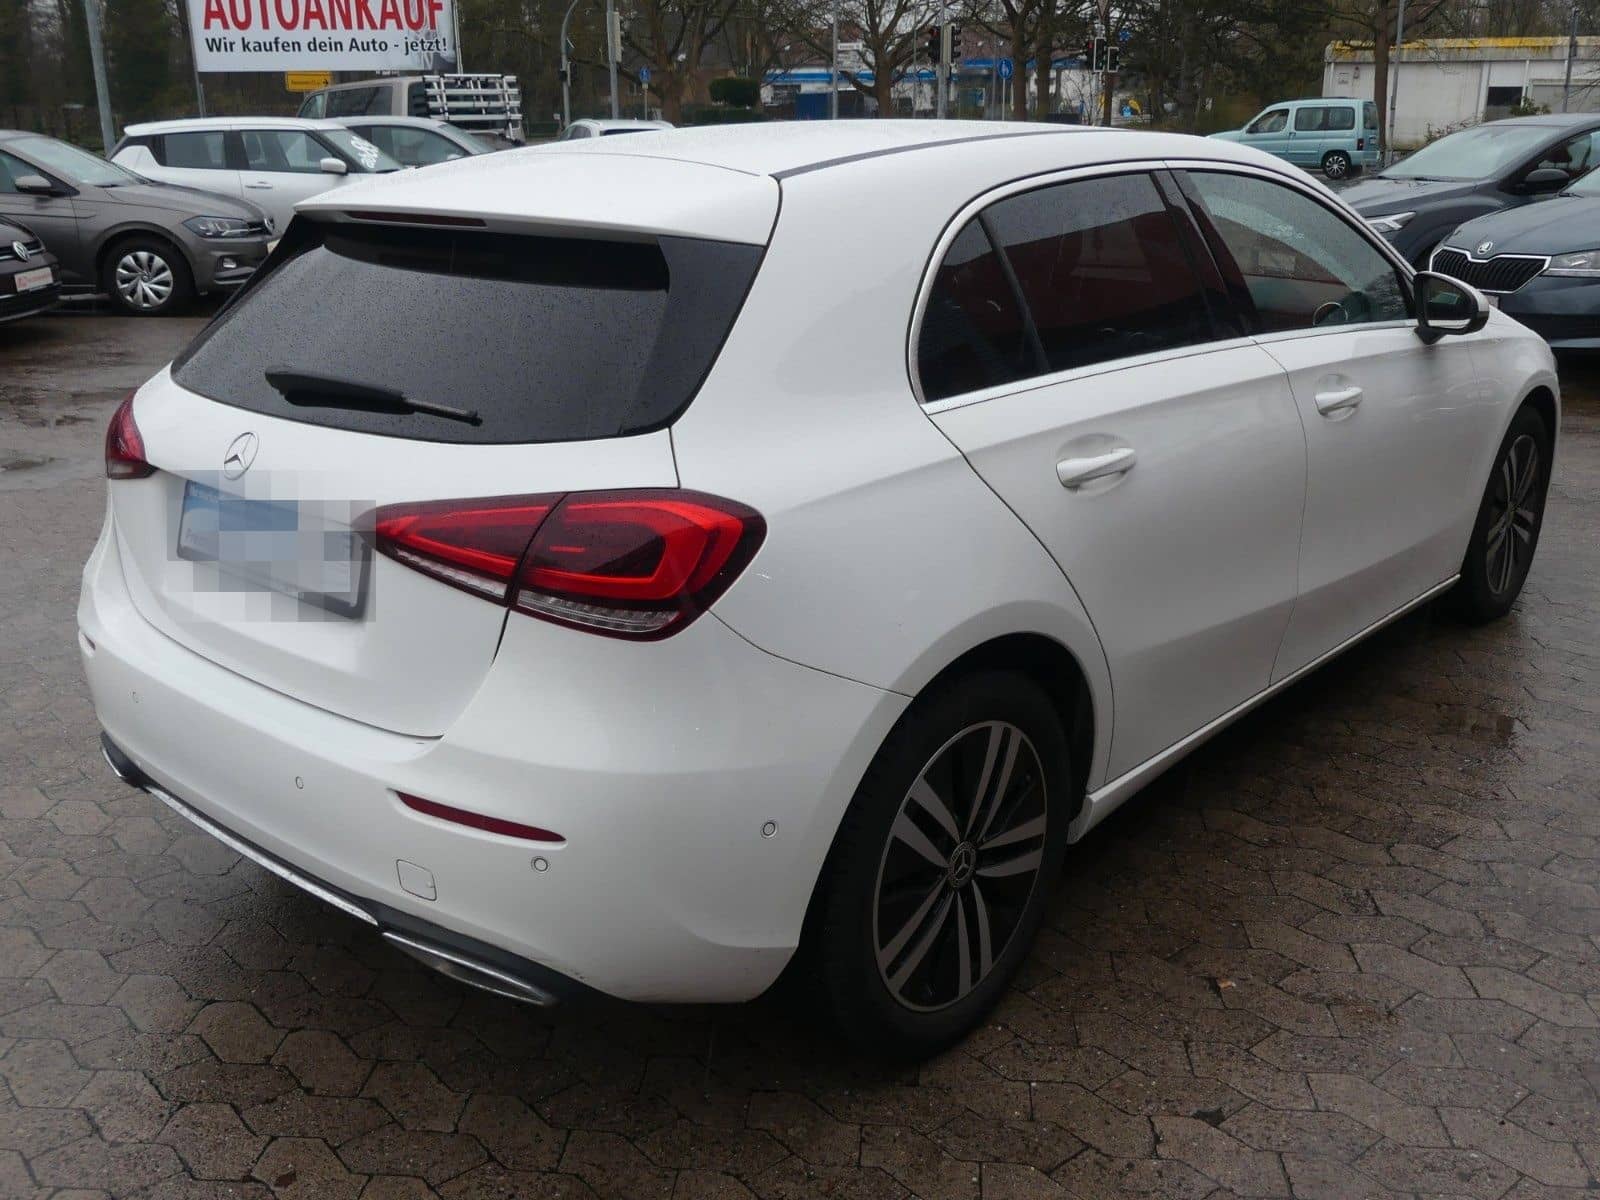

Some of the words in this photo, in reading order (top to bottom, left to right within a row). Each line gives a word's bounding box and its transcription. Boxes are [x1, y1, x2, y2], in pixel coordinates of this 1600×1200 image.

[203, 0, 443, 31] AUTOANKAUF
[205, 37, 236, 52] Wir
[241, 36, 302, 52] kaufen
[307, 36, 343, 52] dein
[348, 37, 388, 52] Auto
[404, 36, 447, 56] jetzt!
